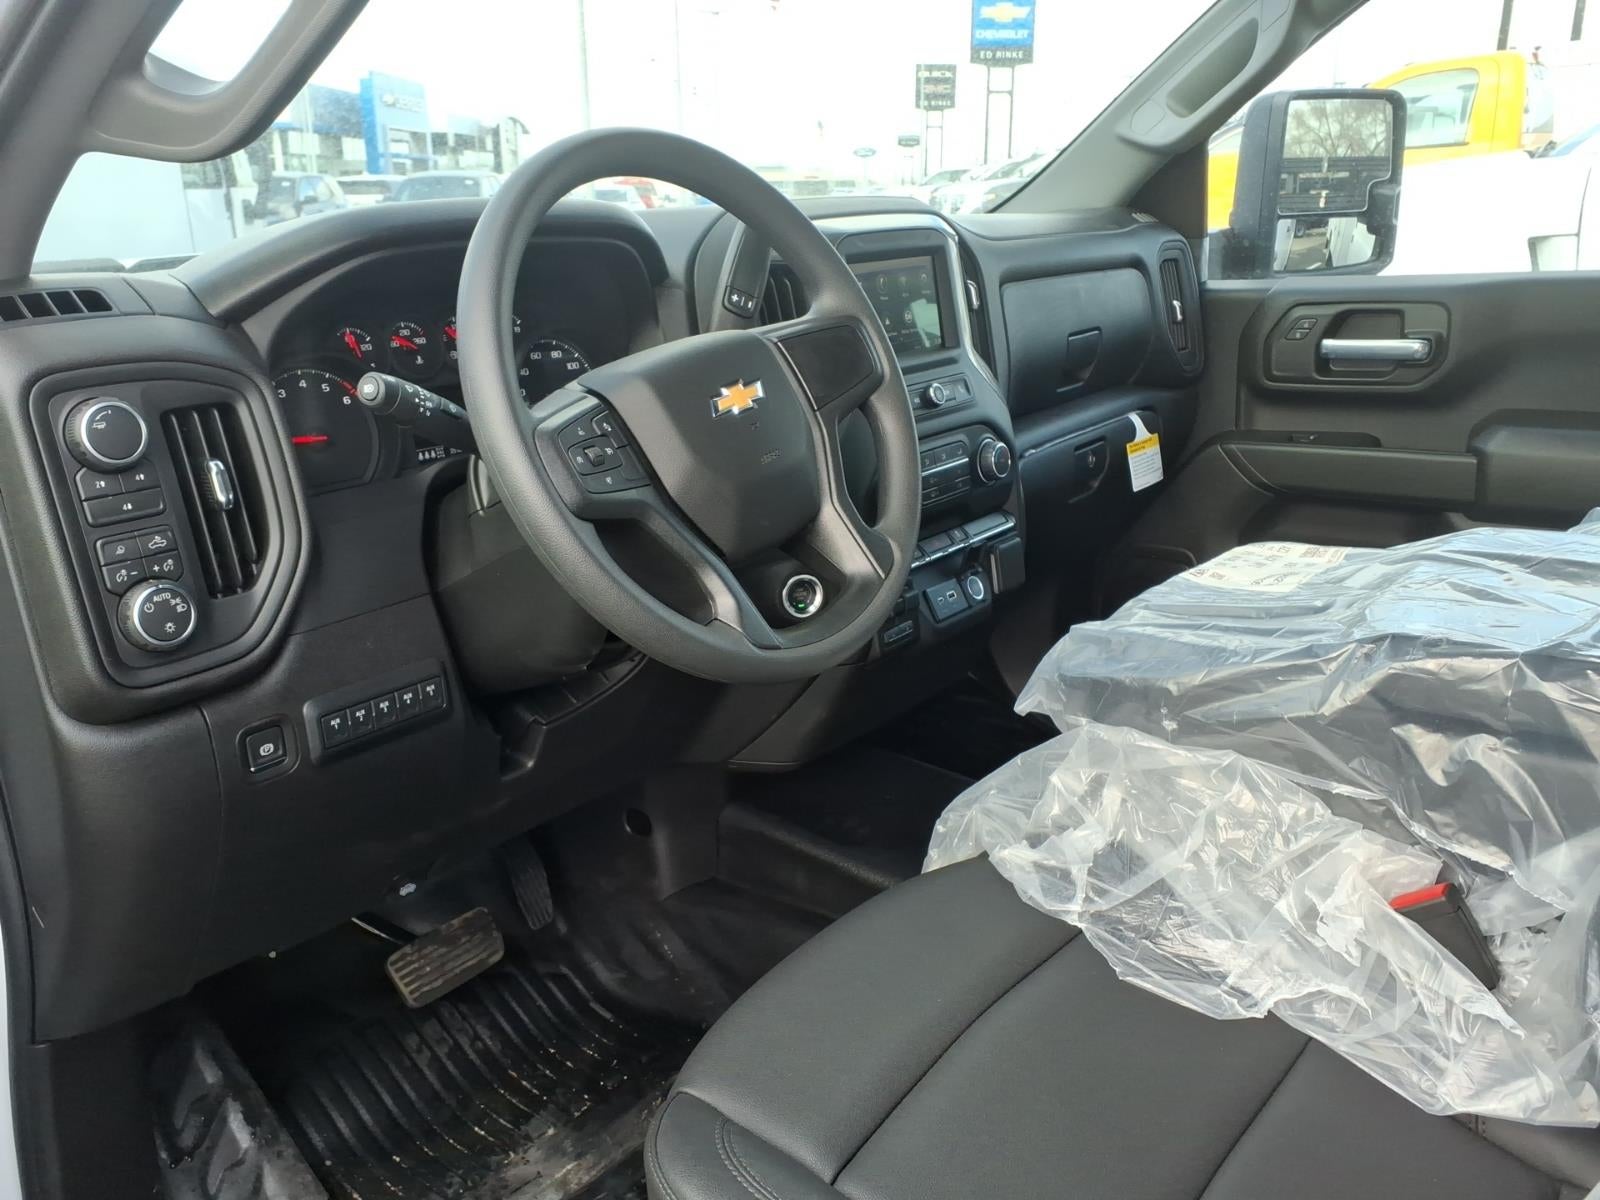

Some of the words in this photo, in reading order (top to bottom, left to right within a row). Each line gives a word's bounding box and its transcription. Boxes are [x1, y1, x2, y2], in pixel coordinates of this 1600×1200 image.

[979, 50, 993, 59] ED
[530, 351, 542, 360] 60
[550, 350, 562, 359] 80
[566, 361, 580, 370] 100
[298, 379, 307, 389] 4
[321, 383, 331, 393] 5
[277, 388, 287, 399] 3
[342, 395, 352, 406] 6
[153, 592, 172, 603] AUTO
